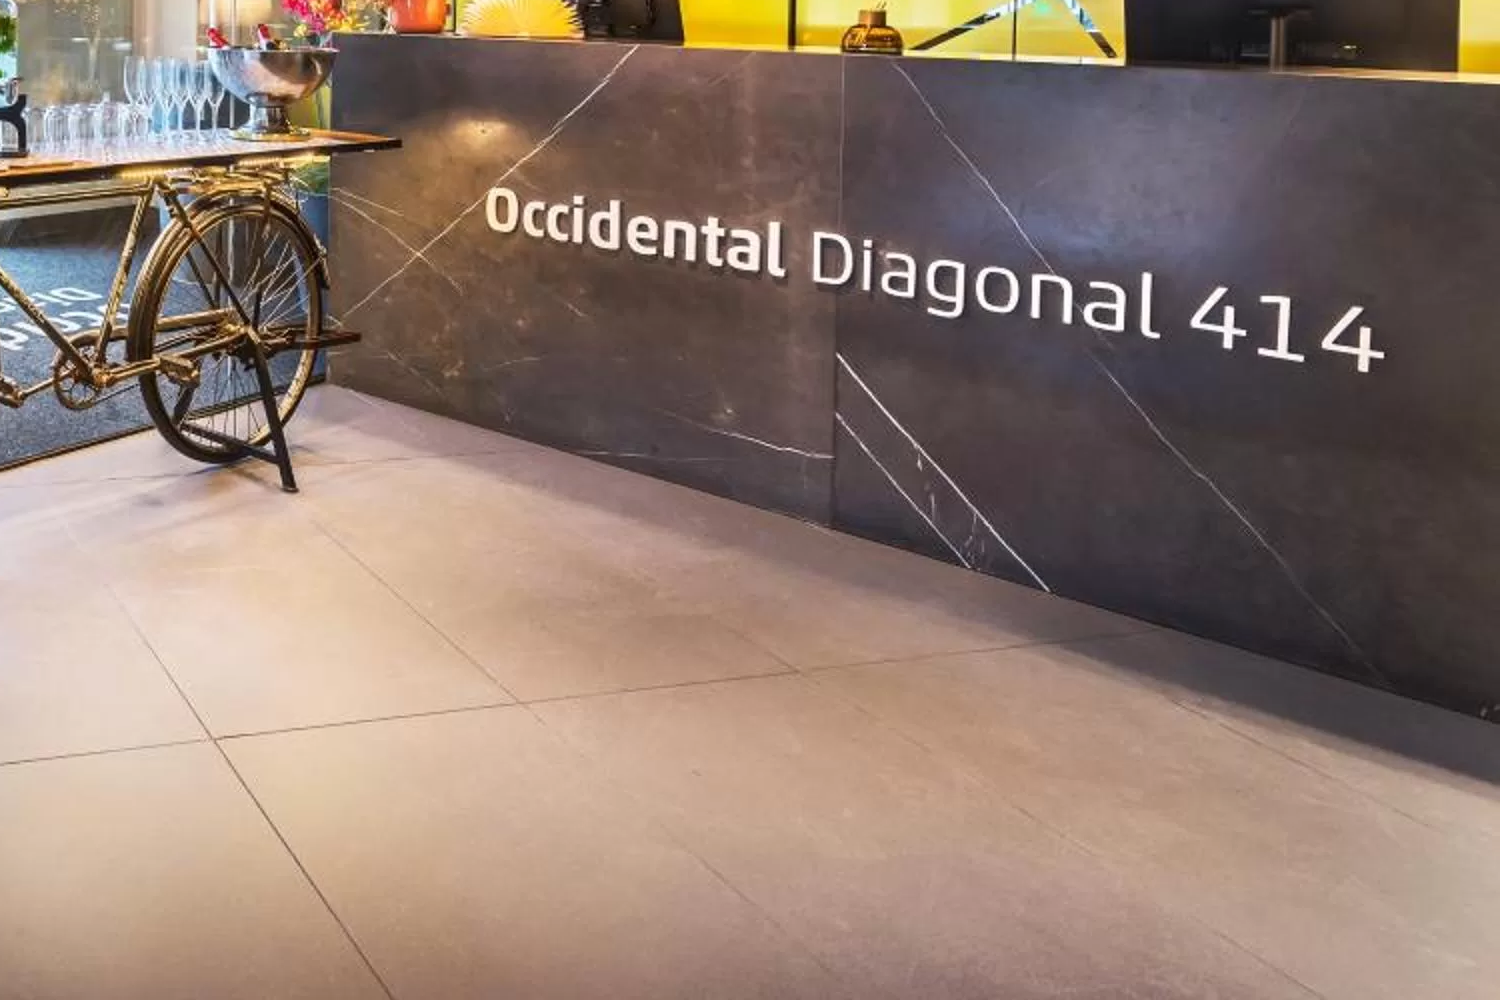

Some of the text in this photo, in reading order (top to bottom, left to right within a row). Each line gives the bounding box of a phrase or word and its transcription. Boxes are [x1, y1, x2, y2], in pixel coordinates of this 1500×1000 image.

[485, 186, 1385, 373] Occidental Diagonal 414
